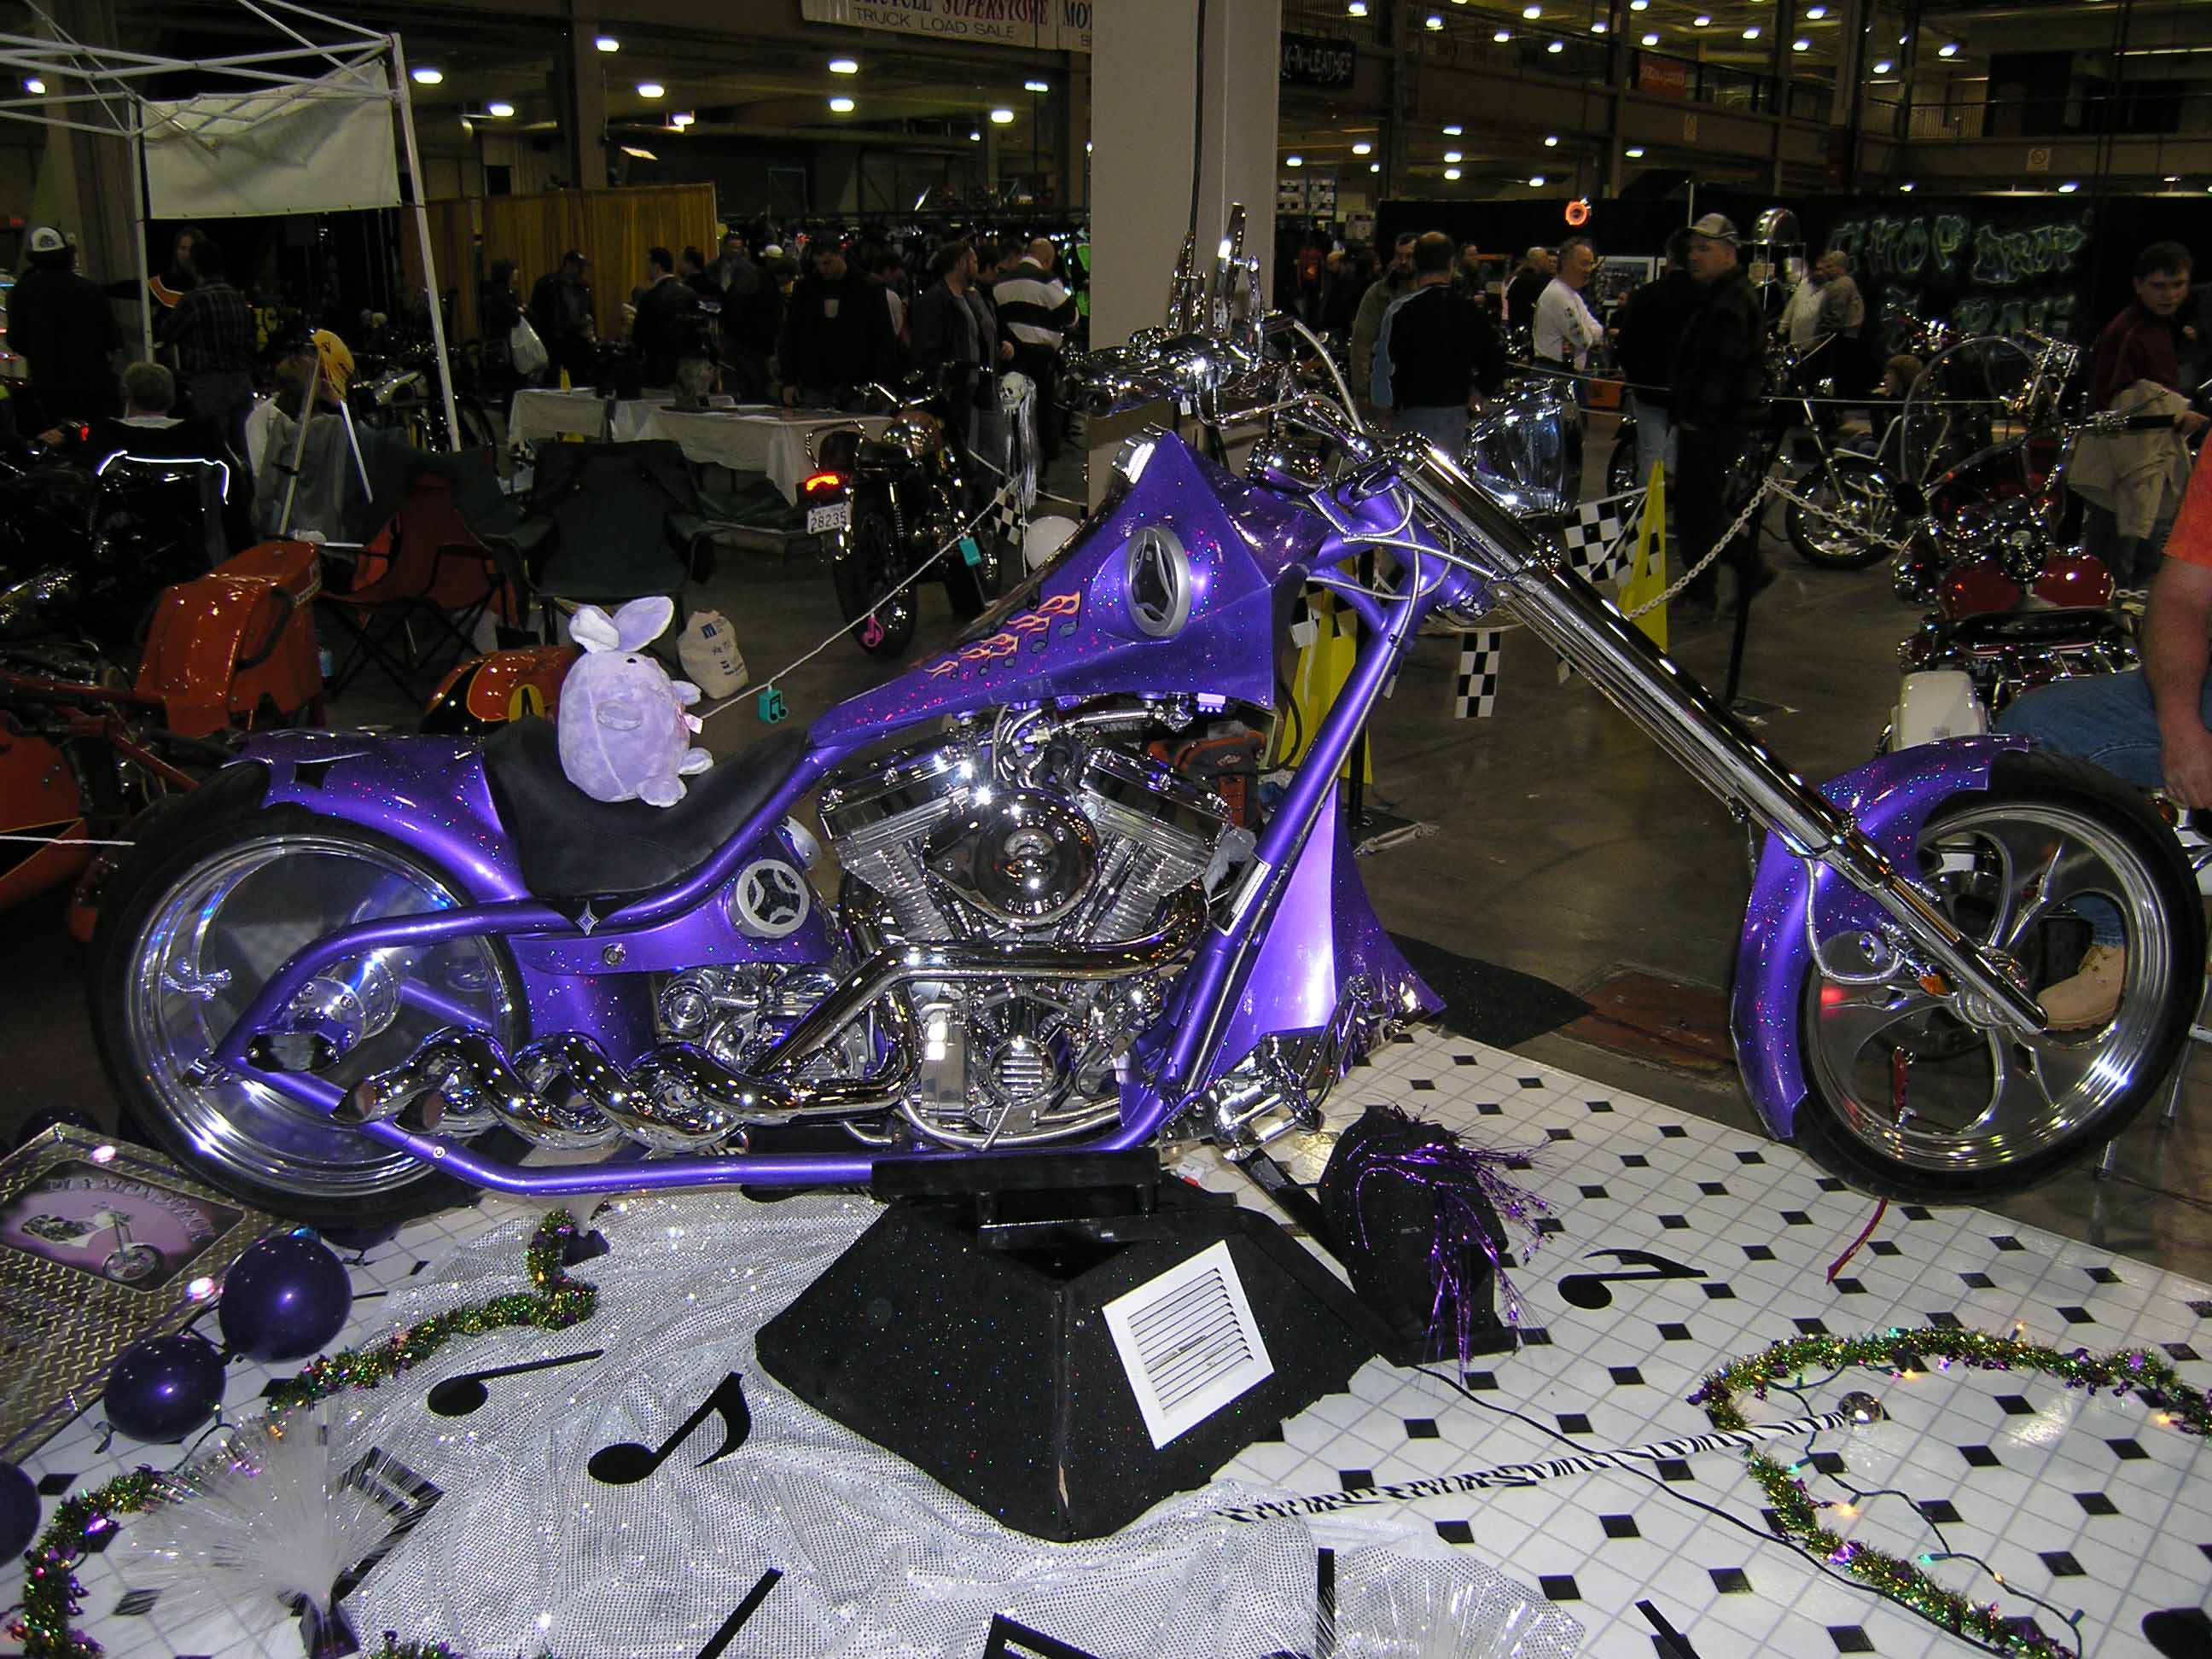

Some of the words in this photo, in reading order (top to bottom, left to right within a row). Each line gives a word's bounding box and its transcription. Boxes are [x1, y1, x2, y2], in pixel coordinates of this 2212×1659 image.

[855, 8, 911, 27] TRUCK
[920, 17, 968, 34] LOAD
[975, 23, 1015, 39] SALE
[811, 511, 847, 529] 28235
